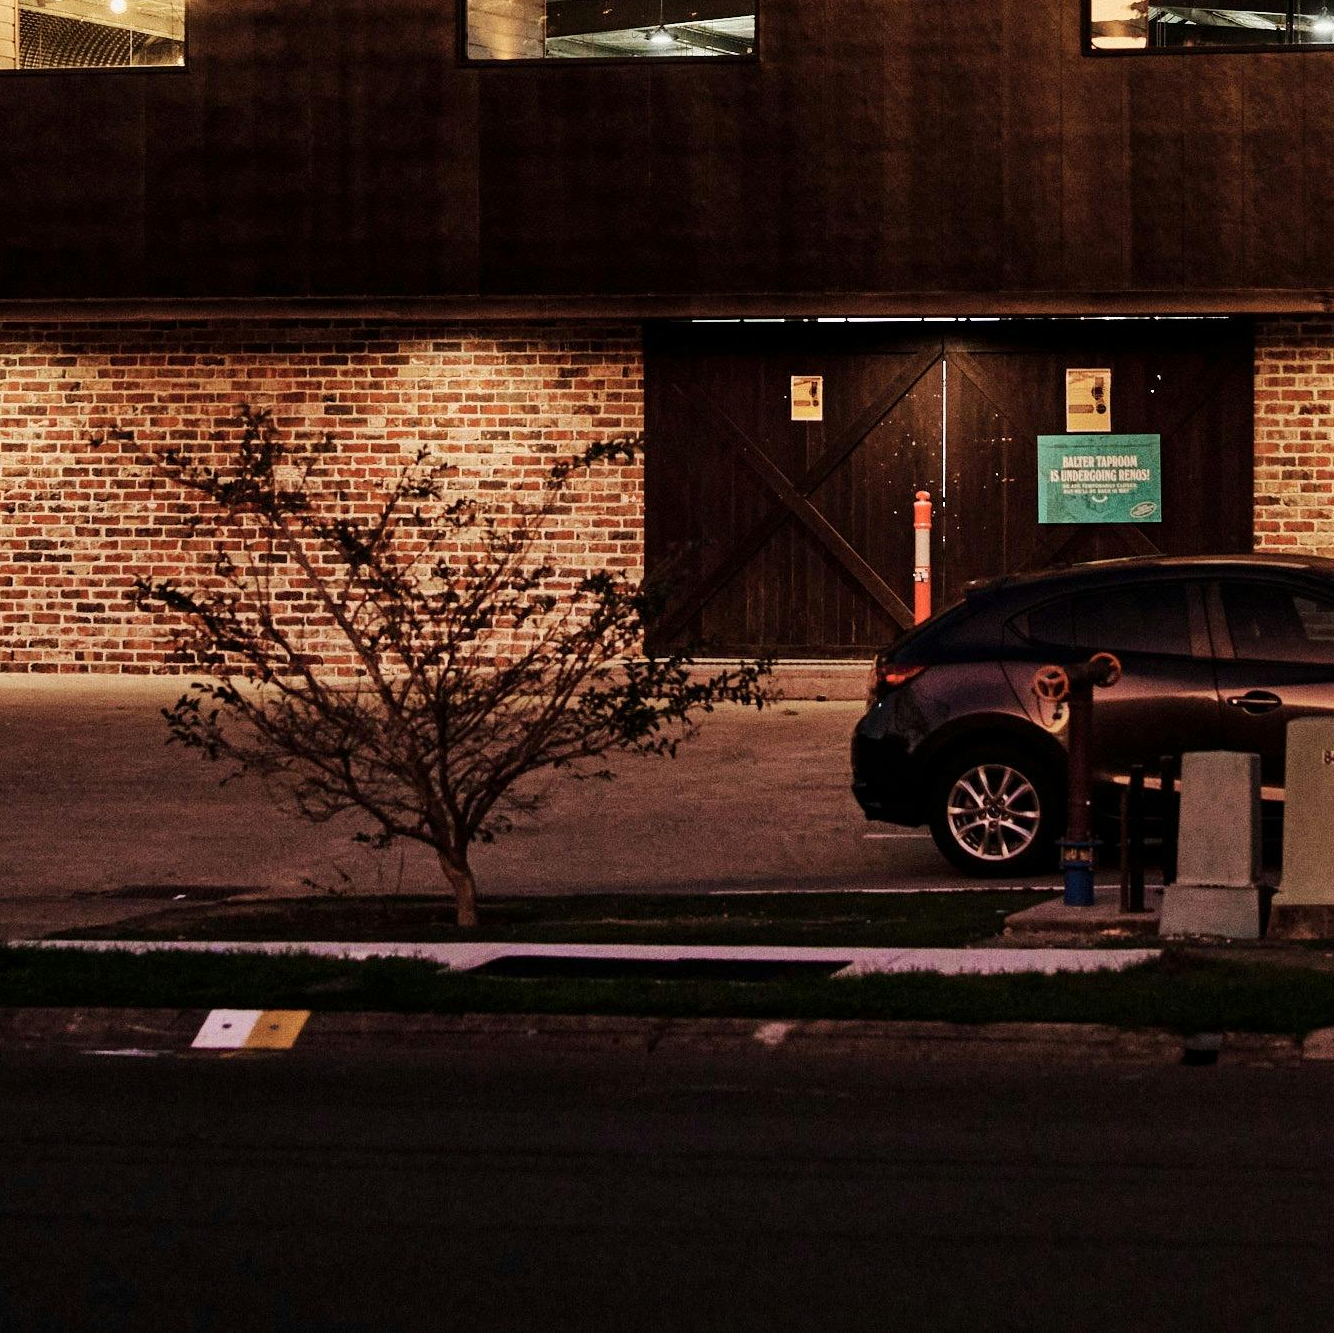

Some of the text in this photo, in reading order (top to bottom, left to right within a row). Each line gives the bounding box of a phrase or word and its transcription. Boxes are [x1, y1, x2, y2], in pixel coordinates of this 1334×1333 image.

[1063, 455, 1138, 468] BALTER TAPROOM
[1051, 469, 1150, 482] IS UNDERGOING RENOS!
